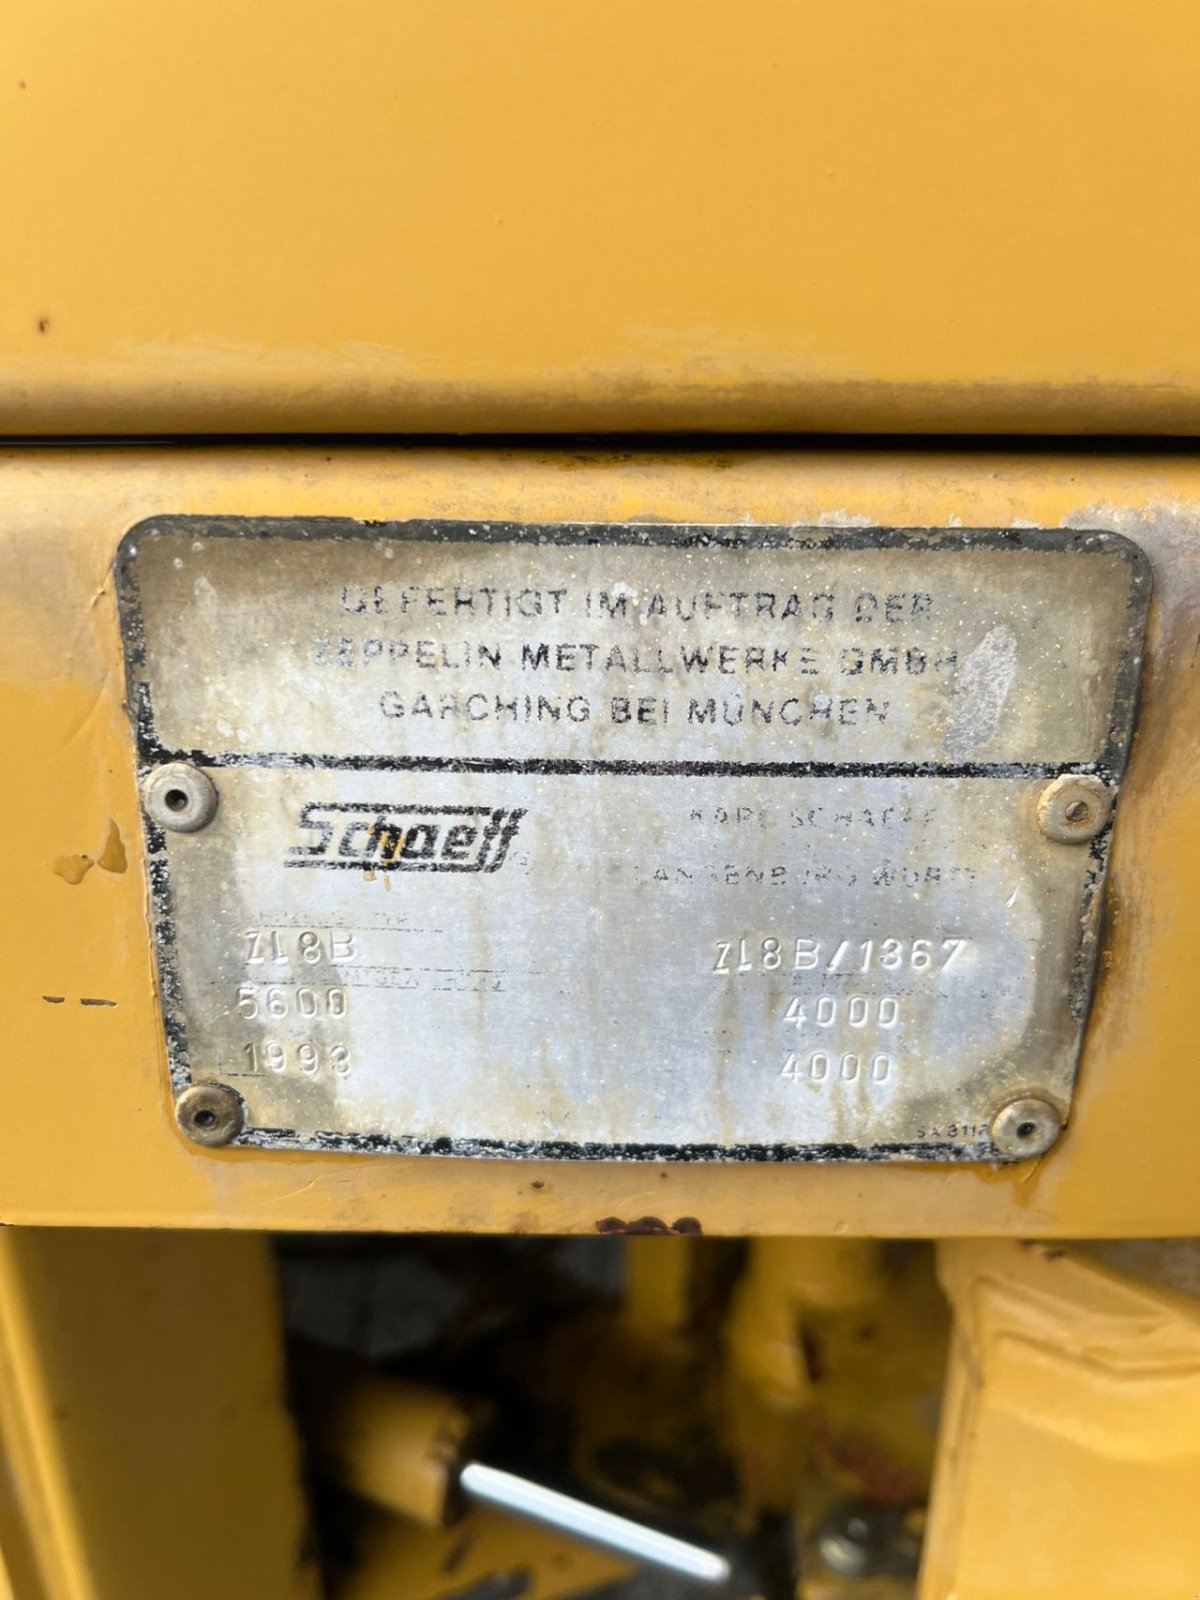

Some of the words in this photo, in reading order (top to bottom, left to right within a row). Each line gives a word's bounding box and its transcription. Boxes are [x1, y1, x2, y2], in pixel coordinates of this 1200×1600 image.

[585, 590, 627, 619] IM
[855, 592, 932, 623] DER
[521, 642, 819, 674] METALLWERKE
[379, 690, 590, 723] GARCHING
[610, 696, 669, 724] BEI
[712, 937, 968, 974] ZL8B/1367
[236, 985, 346, 1020] 5600
[783, 994, 899, 1029] 4000
[243, 1039, 351, 1076] 1993
[779, 1053, 891, 1083] 4000
